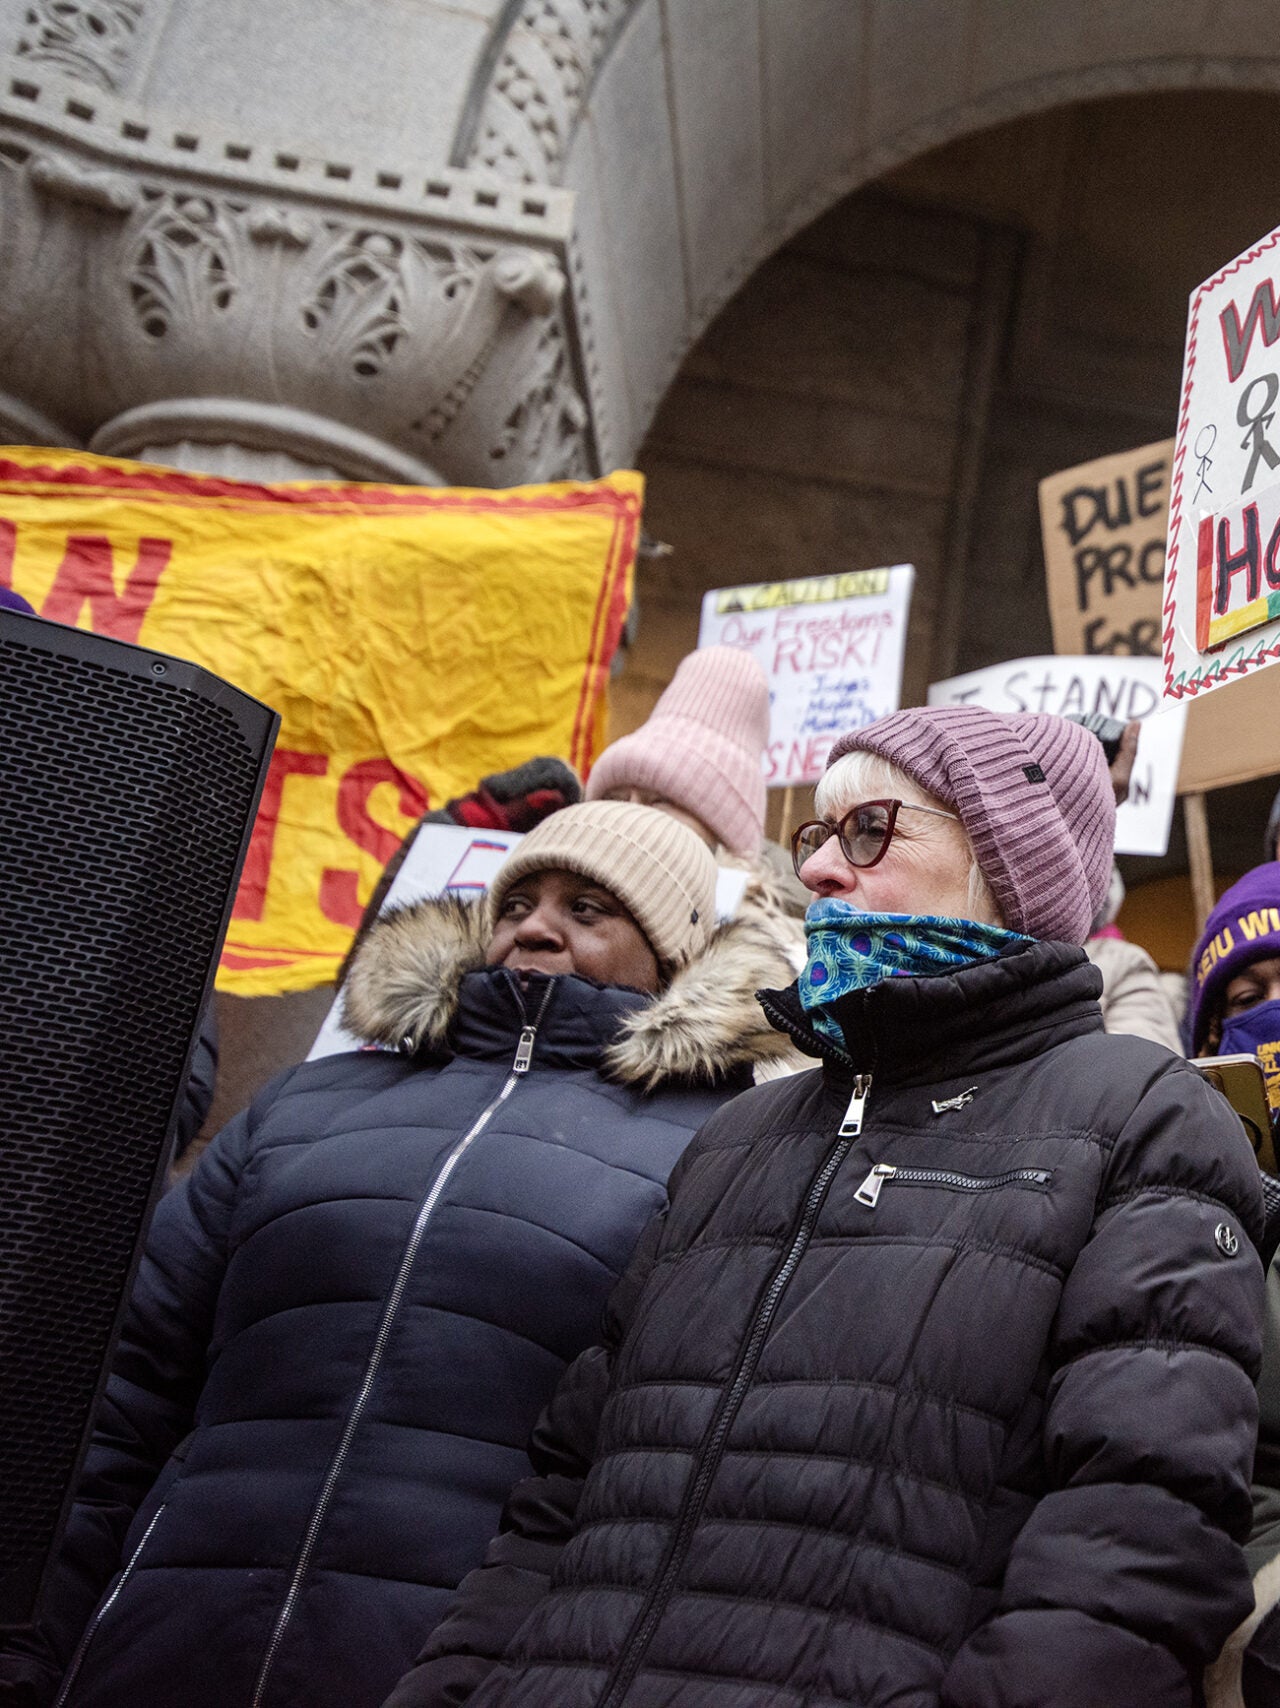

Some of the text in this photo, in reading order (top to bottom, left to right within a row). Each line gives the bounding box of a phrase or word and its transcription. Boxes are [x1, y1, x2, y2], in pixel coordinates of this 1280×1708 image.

[1061, 461, 1166, 546] DUE
[752, 571, 879, 610] CAUTION
[720, 614, 767, 648] Our
